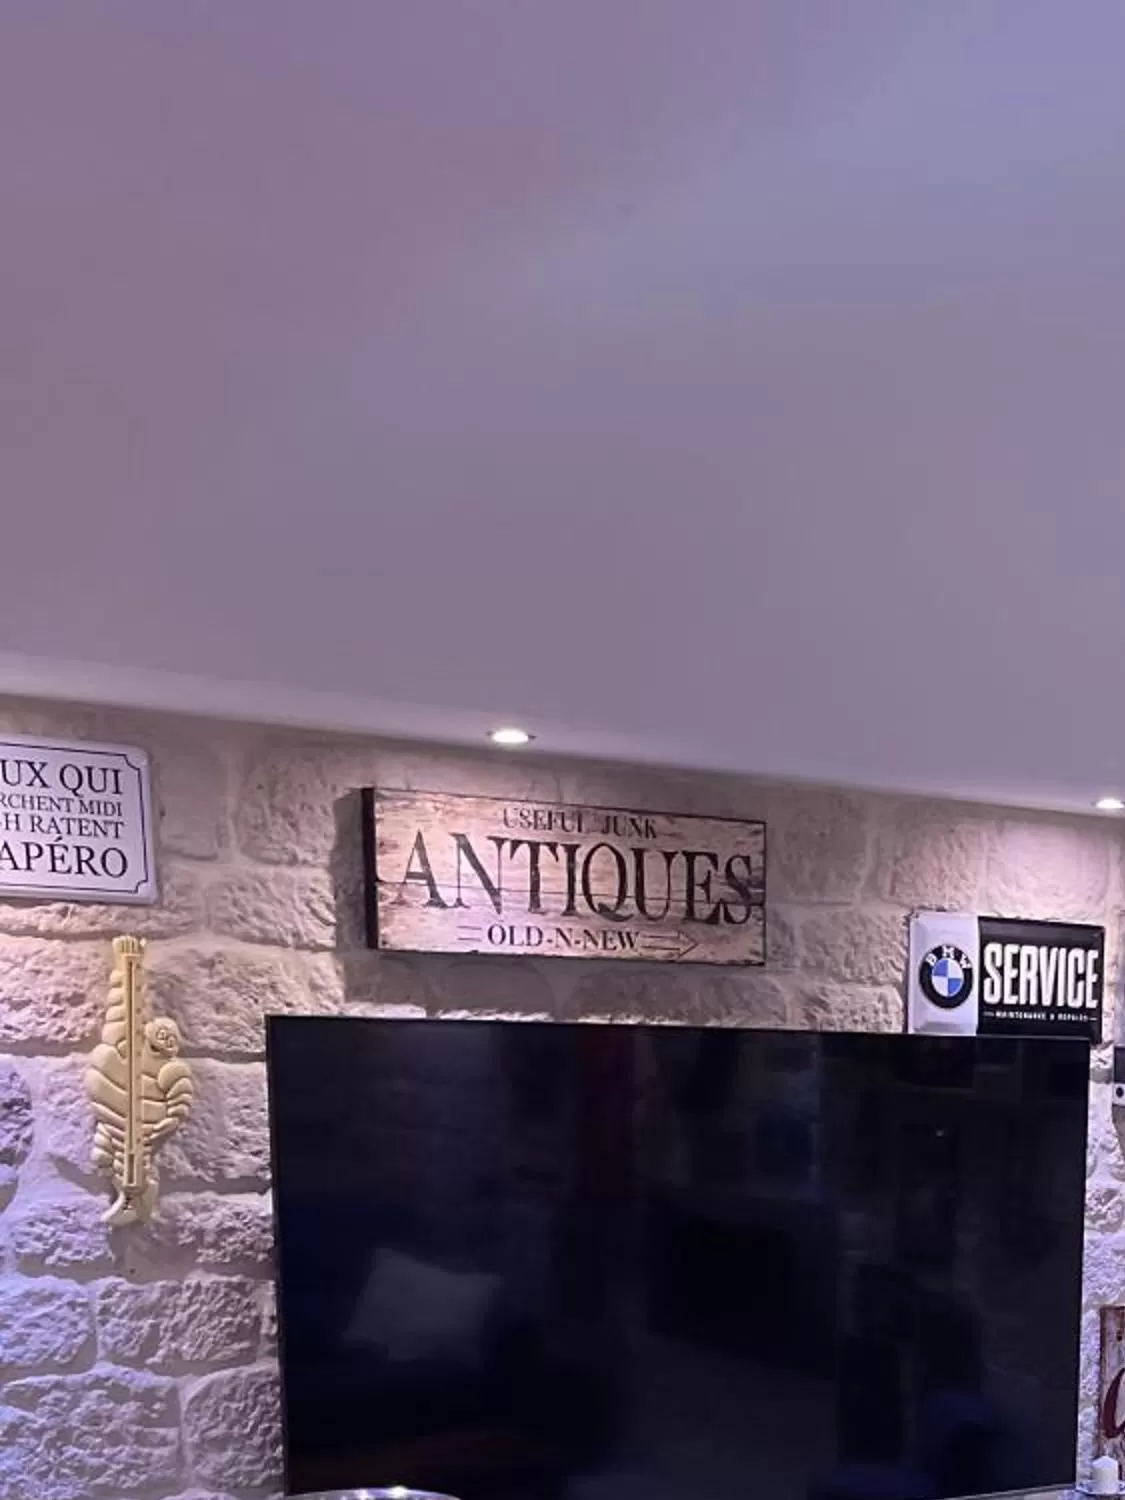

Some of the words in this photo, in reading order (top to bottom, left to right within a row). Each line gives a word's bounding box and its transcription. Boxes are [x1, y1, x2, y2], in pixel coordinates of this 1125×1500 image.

[59, 763, 123, 798] QUI
[79, 799, 123, 817] MIDI
[29, 814, 125, 839] RATENT
[602, 814, 657, 838] JUNK
[390, 828, 753, 926] ANTIQUES
[983, 942, 1100, 1009] SERVICE
